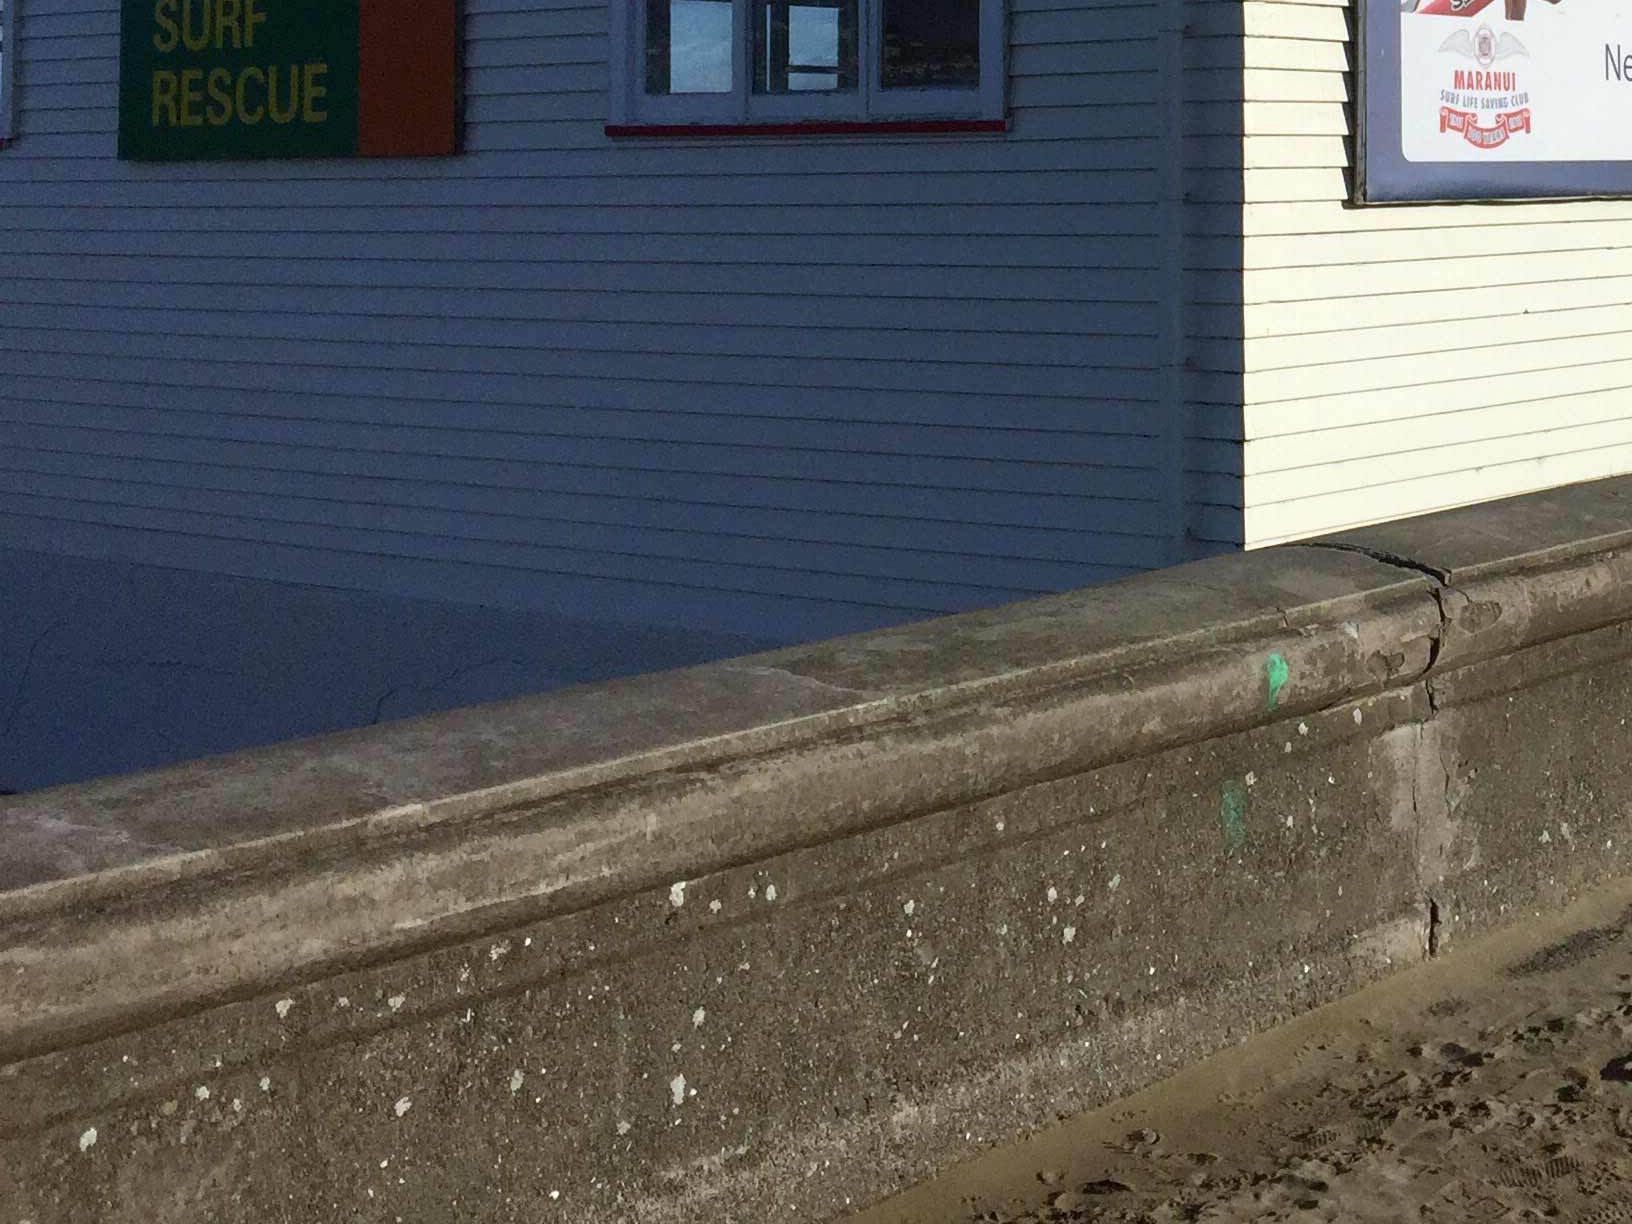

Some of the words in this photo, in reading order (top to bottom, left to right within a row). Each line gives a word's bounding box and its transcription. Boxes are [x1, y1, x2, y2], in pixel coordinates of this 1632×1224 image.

[151, 63, 328, 126] RESCUE
[1440, 89, 1460, 104] SURF
[1462, 95, 1478, 109] LIFE
[1481, 96, 1509, 109] SAVING
[1510, 91, 1529, 107] CLUB
